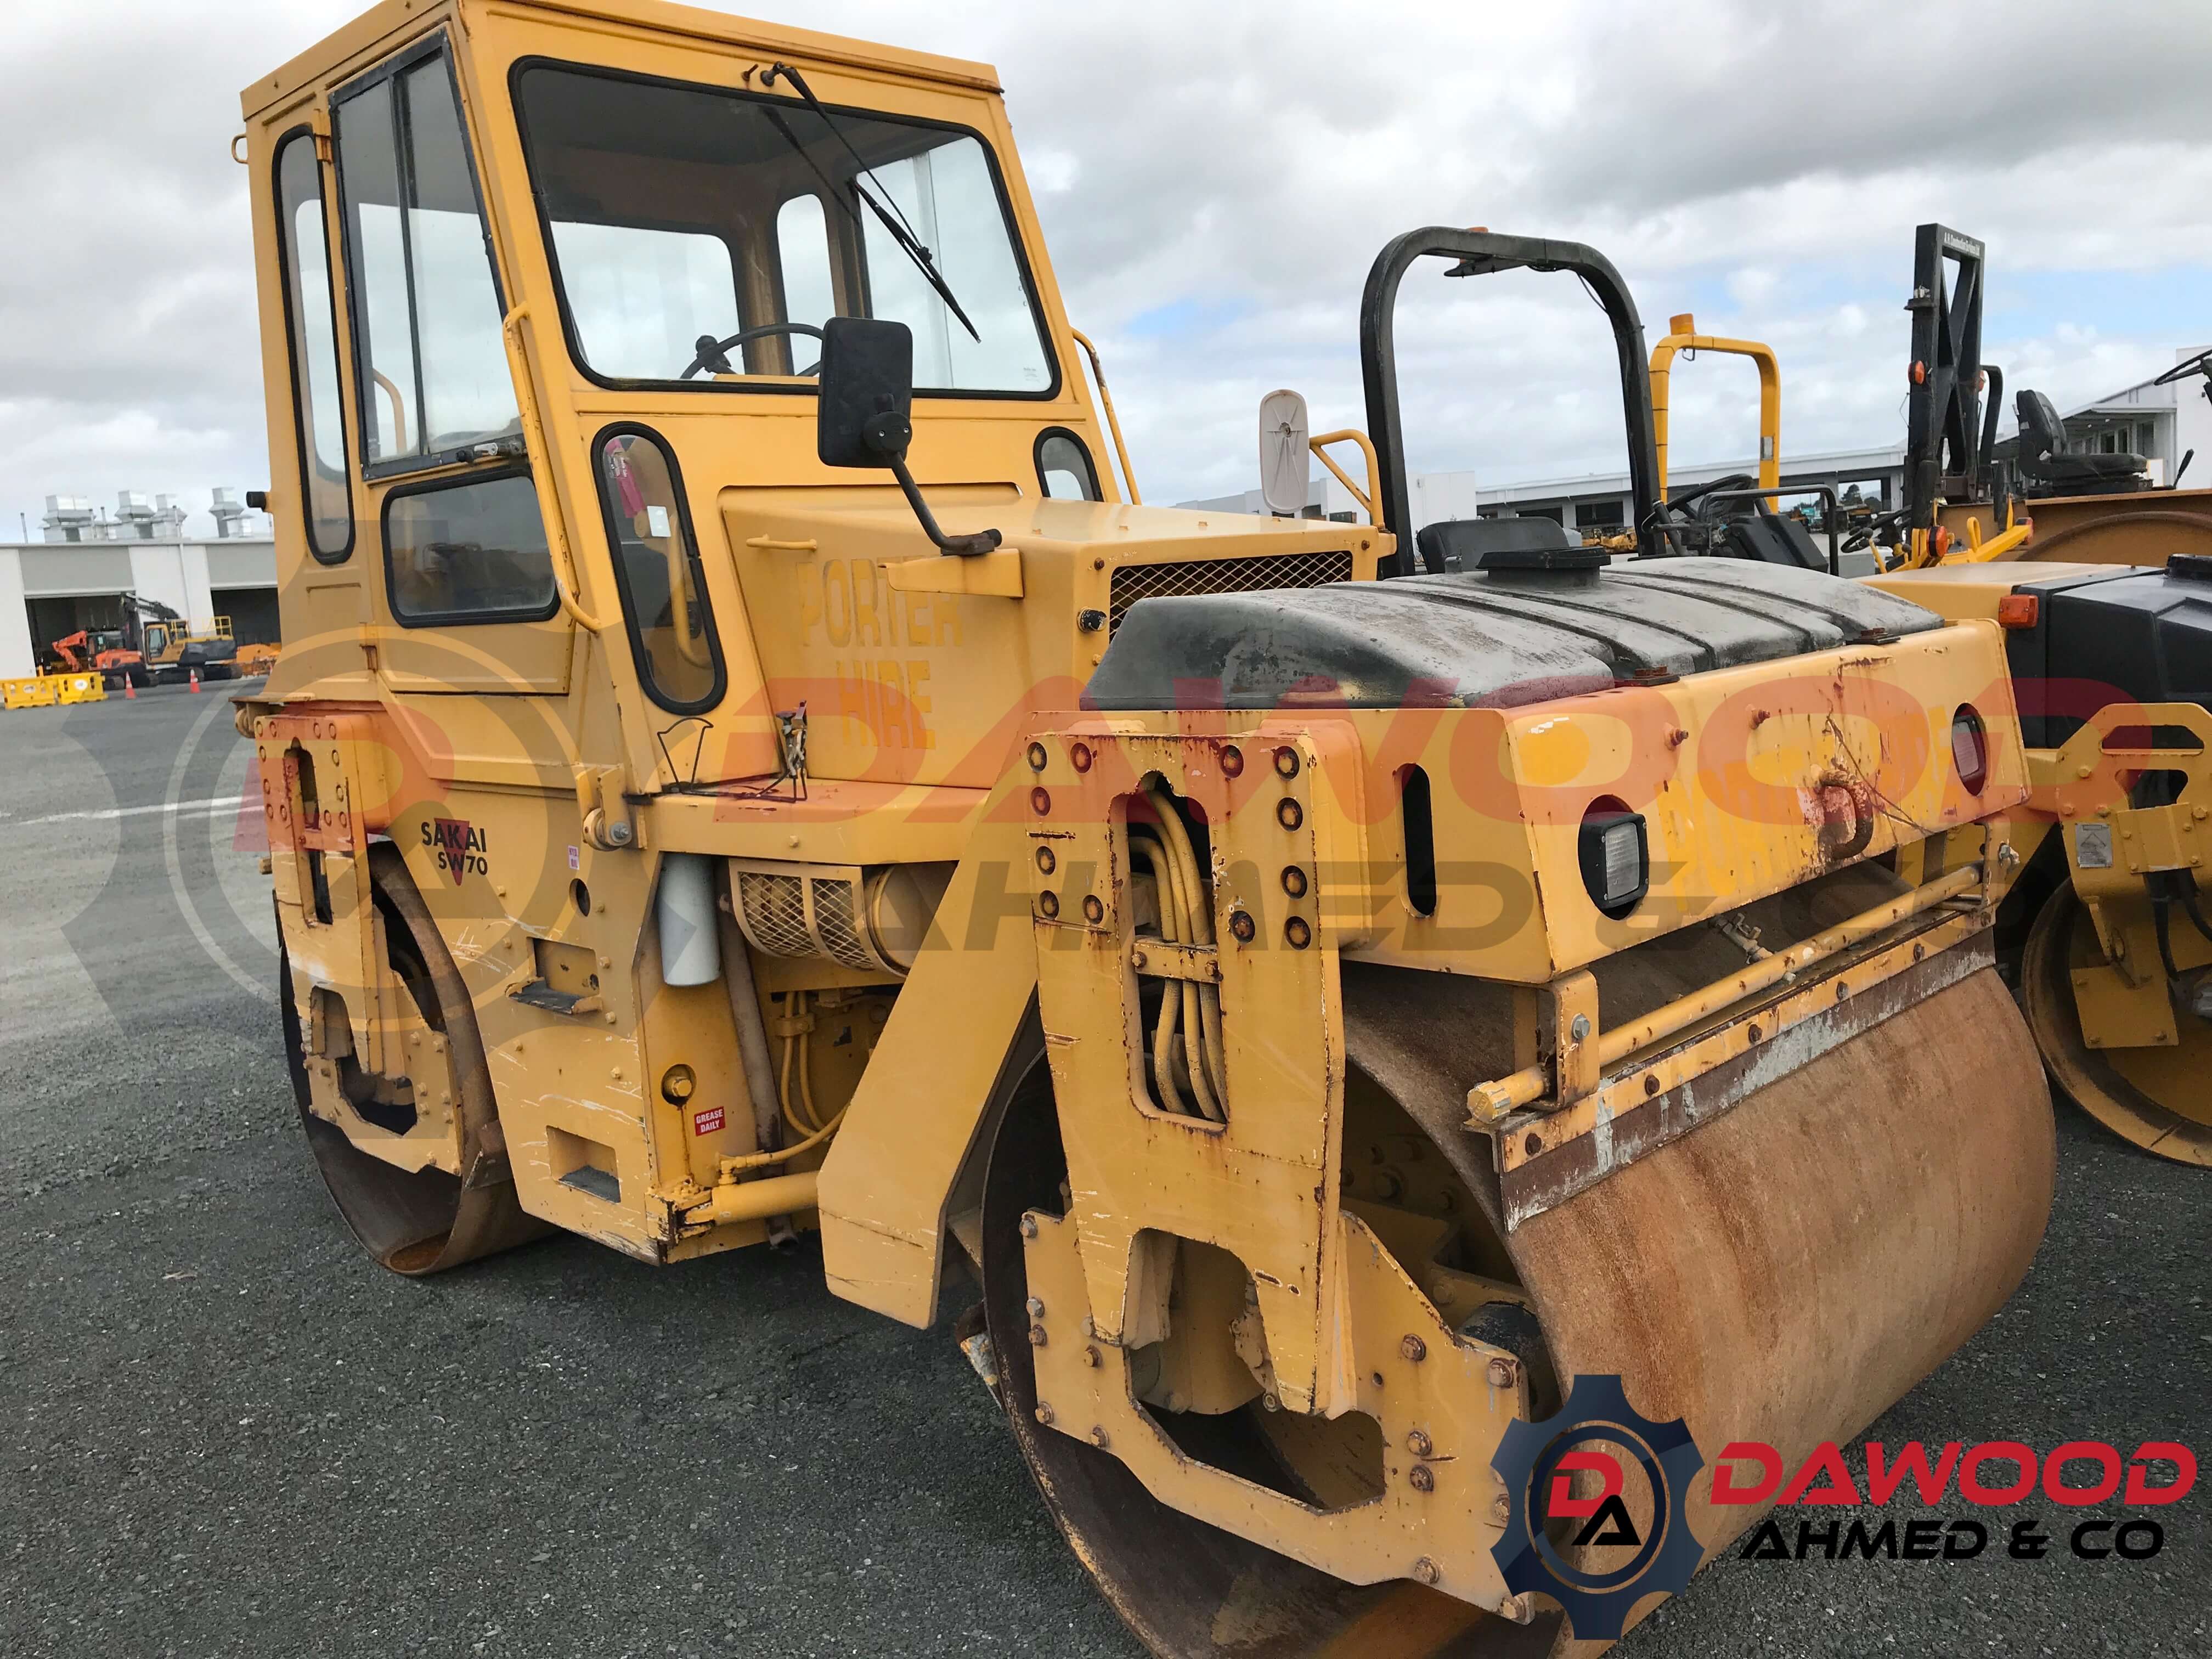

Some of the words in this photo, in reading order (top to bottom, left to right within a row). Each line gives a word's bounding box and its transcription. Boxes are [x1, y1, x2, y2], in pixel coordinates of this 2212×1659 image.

[836, 660, 936, 750] HIRE
[421, 821, 487, 853] SAKAI
[438, 851, 488, 876] SW70
[696, 1109, 724, 1124] GREASE
[700, 1120, 720, 1133] DAILY
